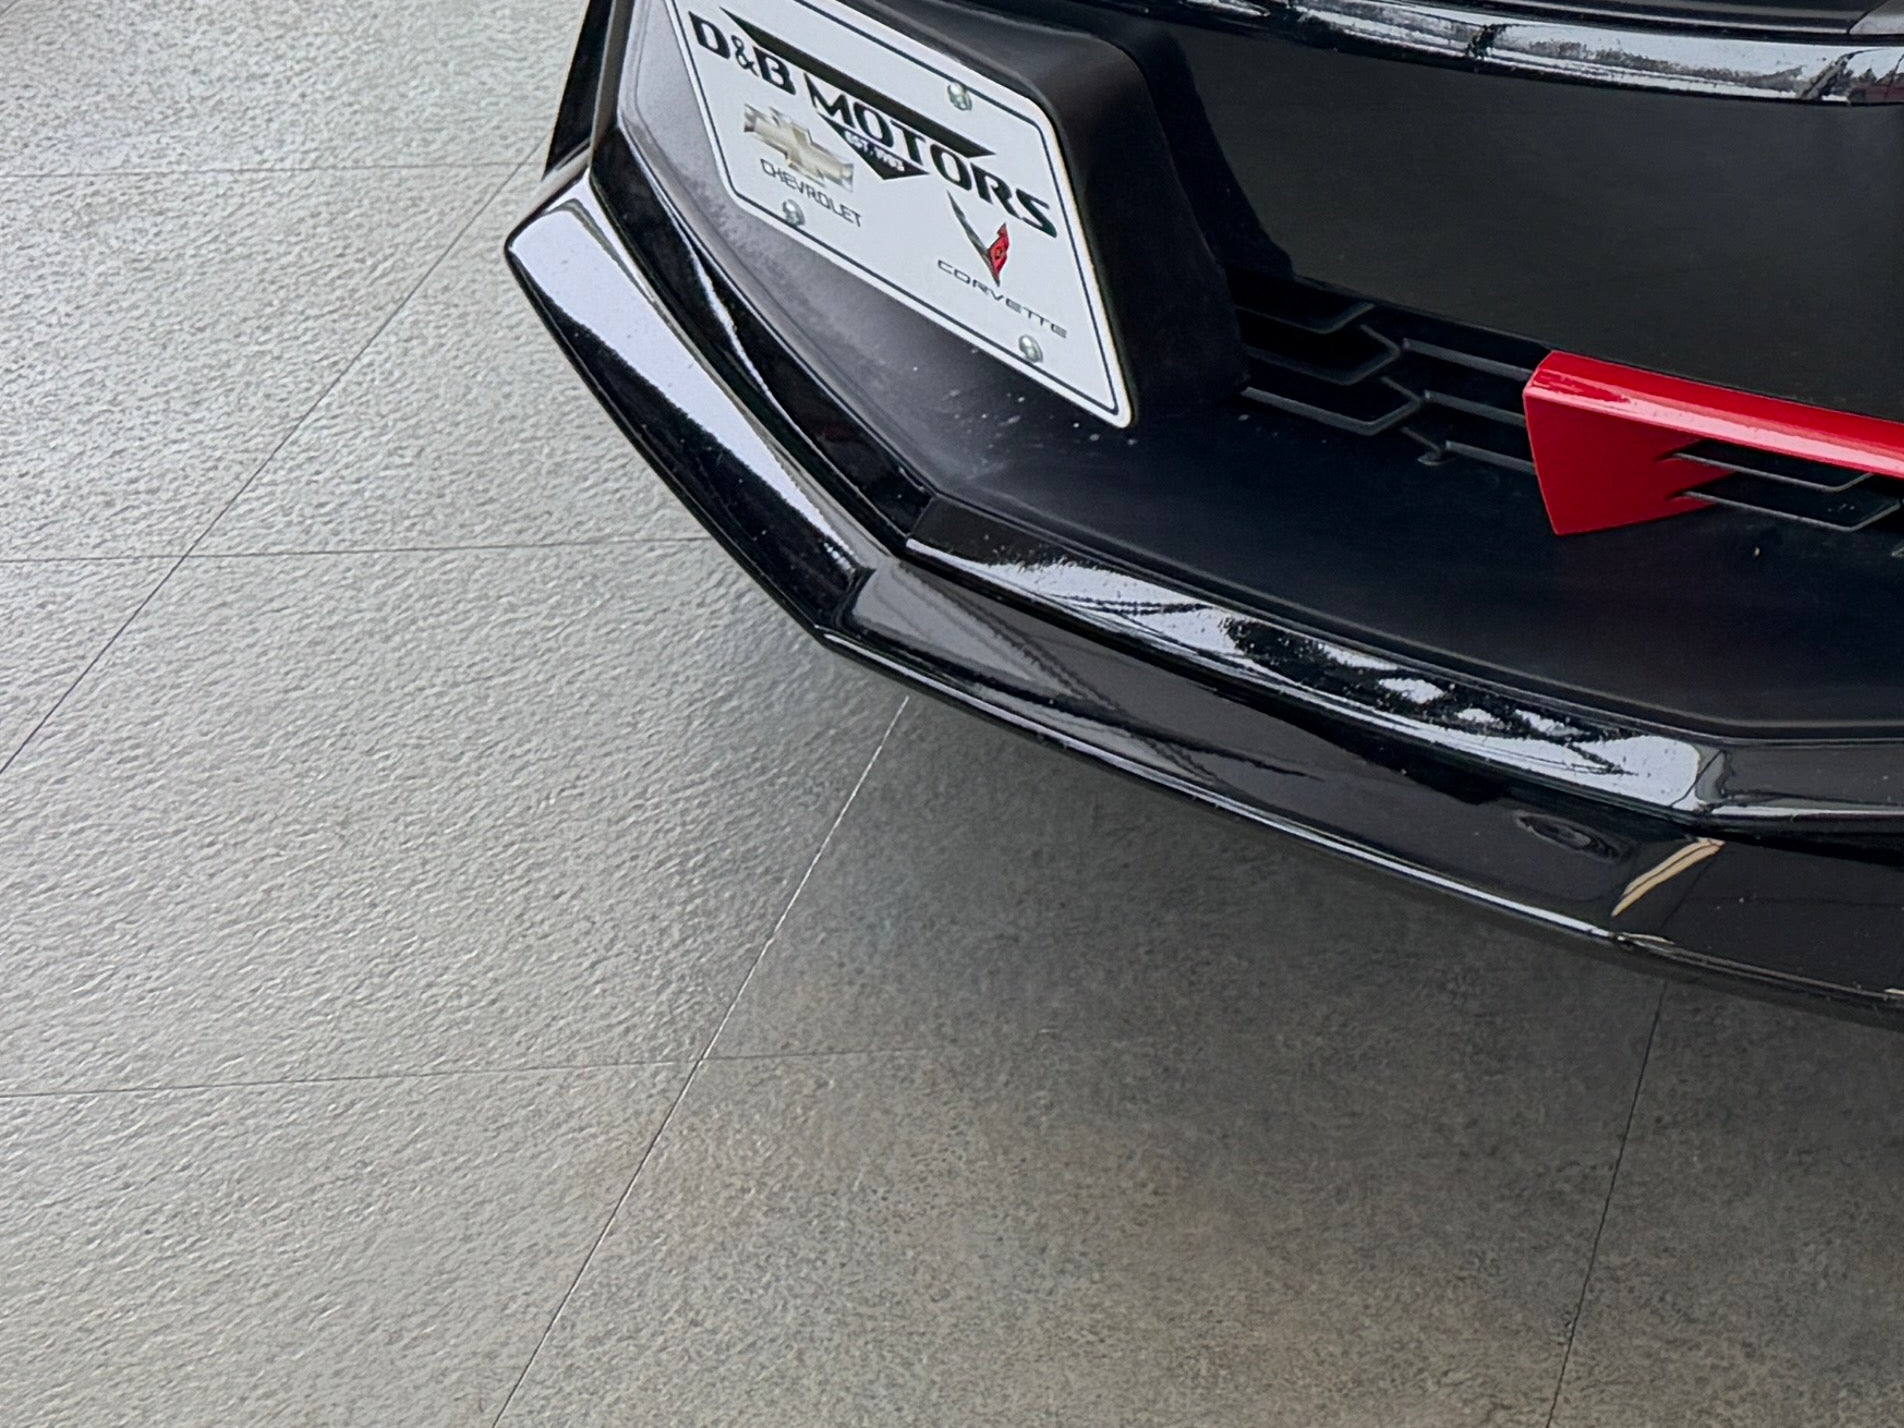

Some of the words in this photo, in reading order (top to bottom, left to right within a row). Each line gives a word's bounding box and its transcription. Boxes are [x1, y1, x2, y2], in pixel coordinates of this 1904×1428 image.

[688, 10, 796, 96] D&B
[803, 72, 1057, 238] MOTORS
[760, 158, 862, 227] CHEVROLET
[937, 259, 1067, 338] CORVETTE
